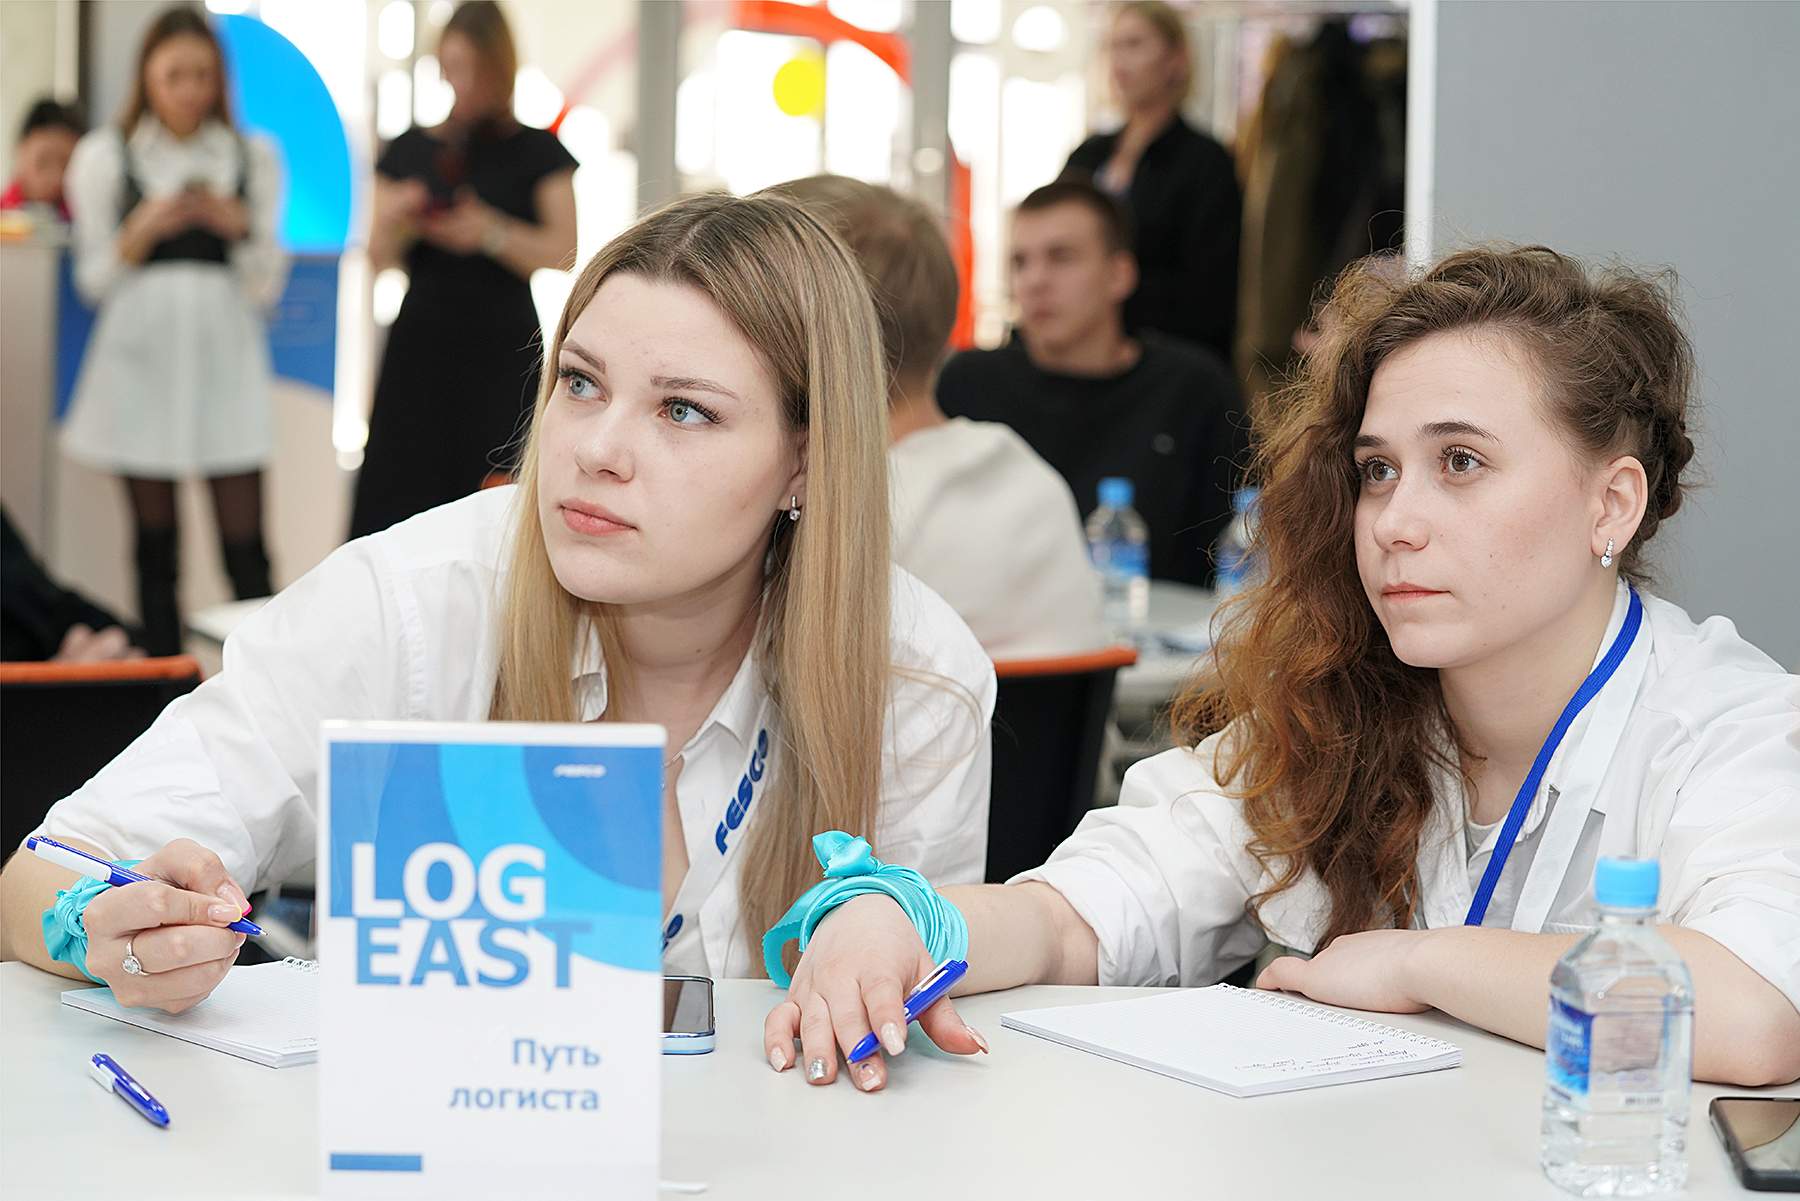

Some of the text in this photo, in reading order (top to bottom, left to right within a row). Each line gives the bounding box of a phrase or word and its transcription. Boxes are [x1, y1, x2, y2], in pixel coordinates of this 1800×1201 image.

[715, 728, 769, 856] FESCO
[351, 842, 547, 921] LOG
[355, 919, 592, 989] EAST
[511, 1038, 600, 1072] Путь
[449, 1087, 600, 1111] логиста
